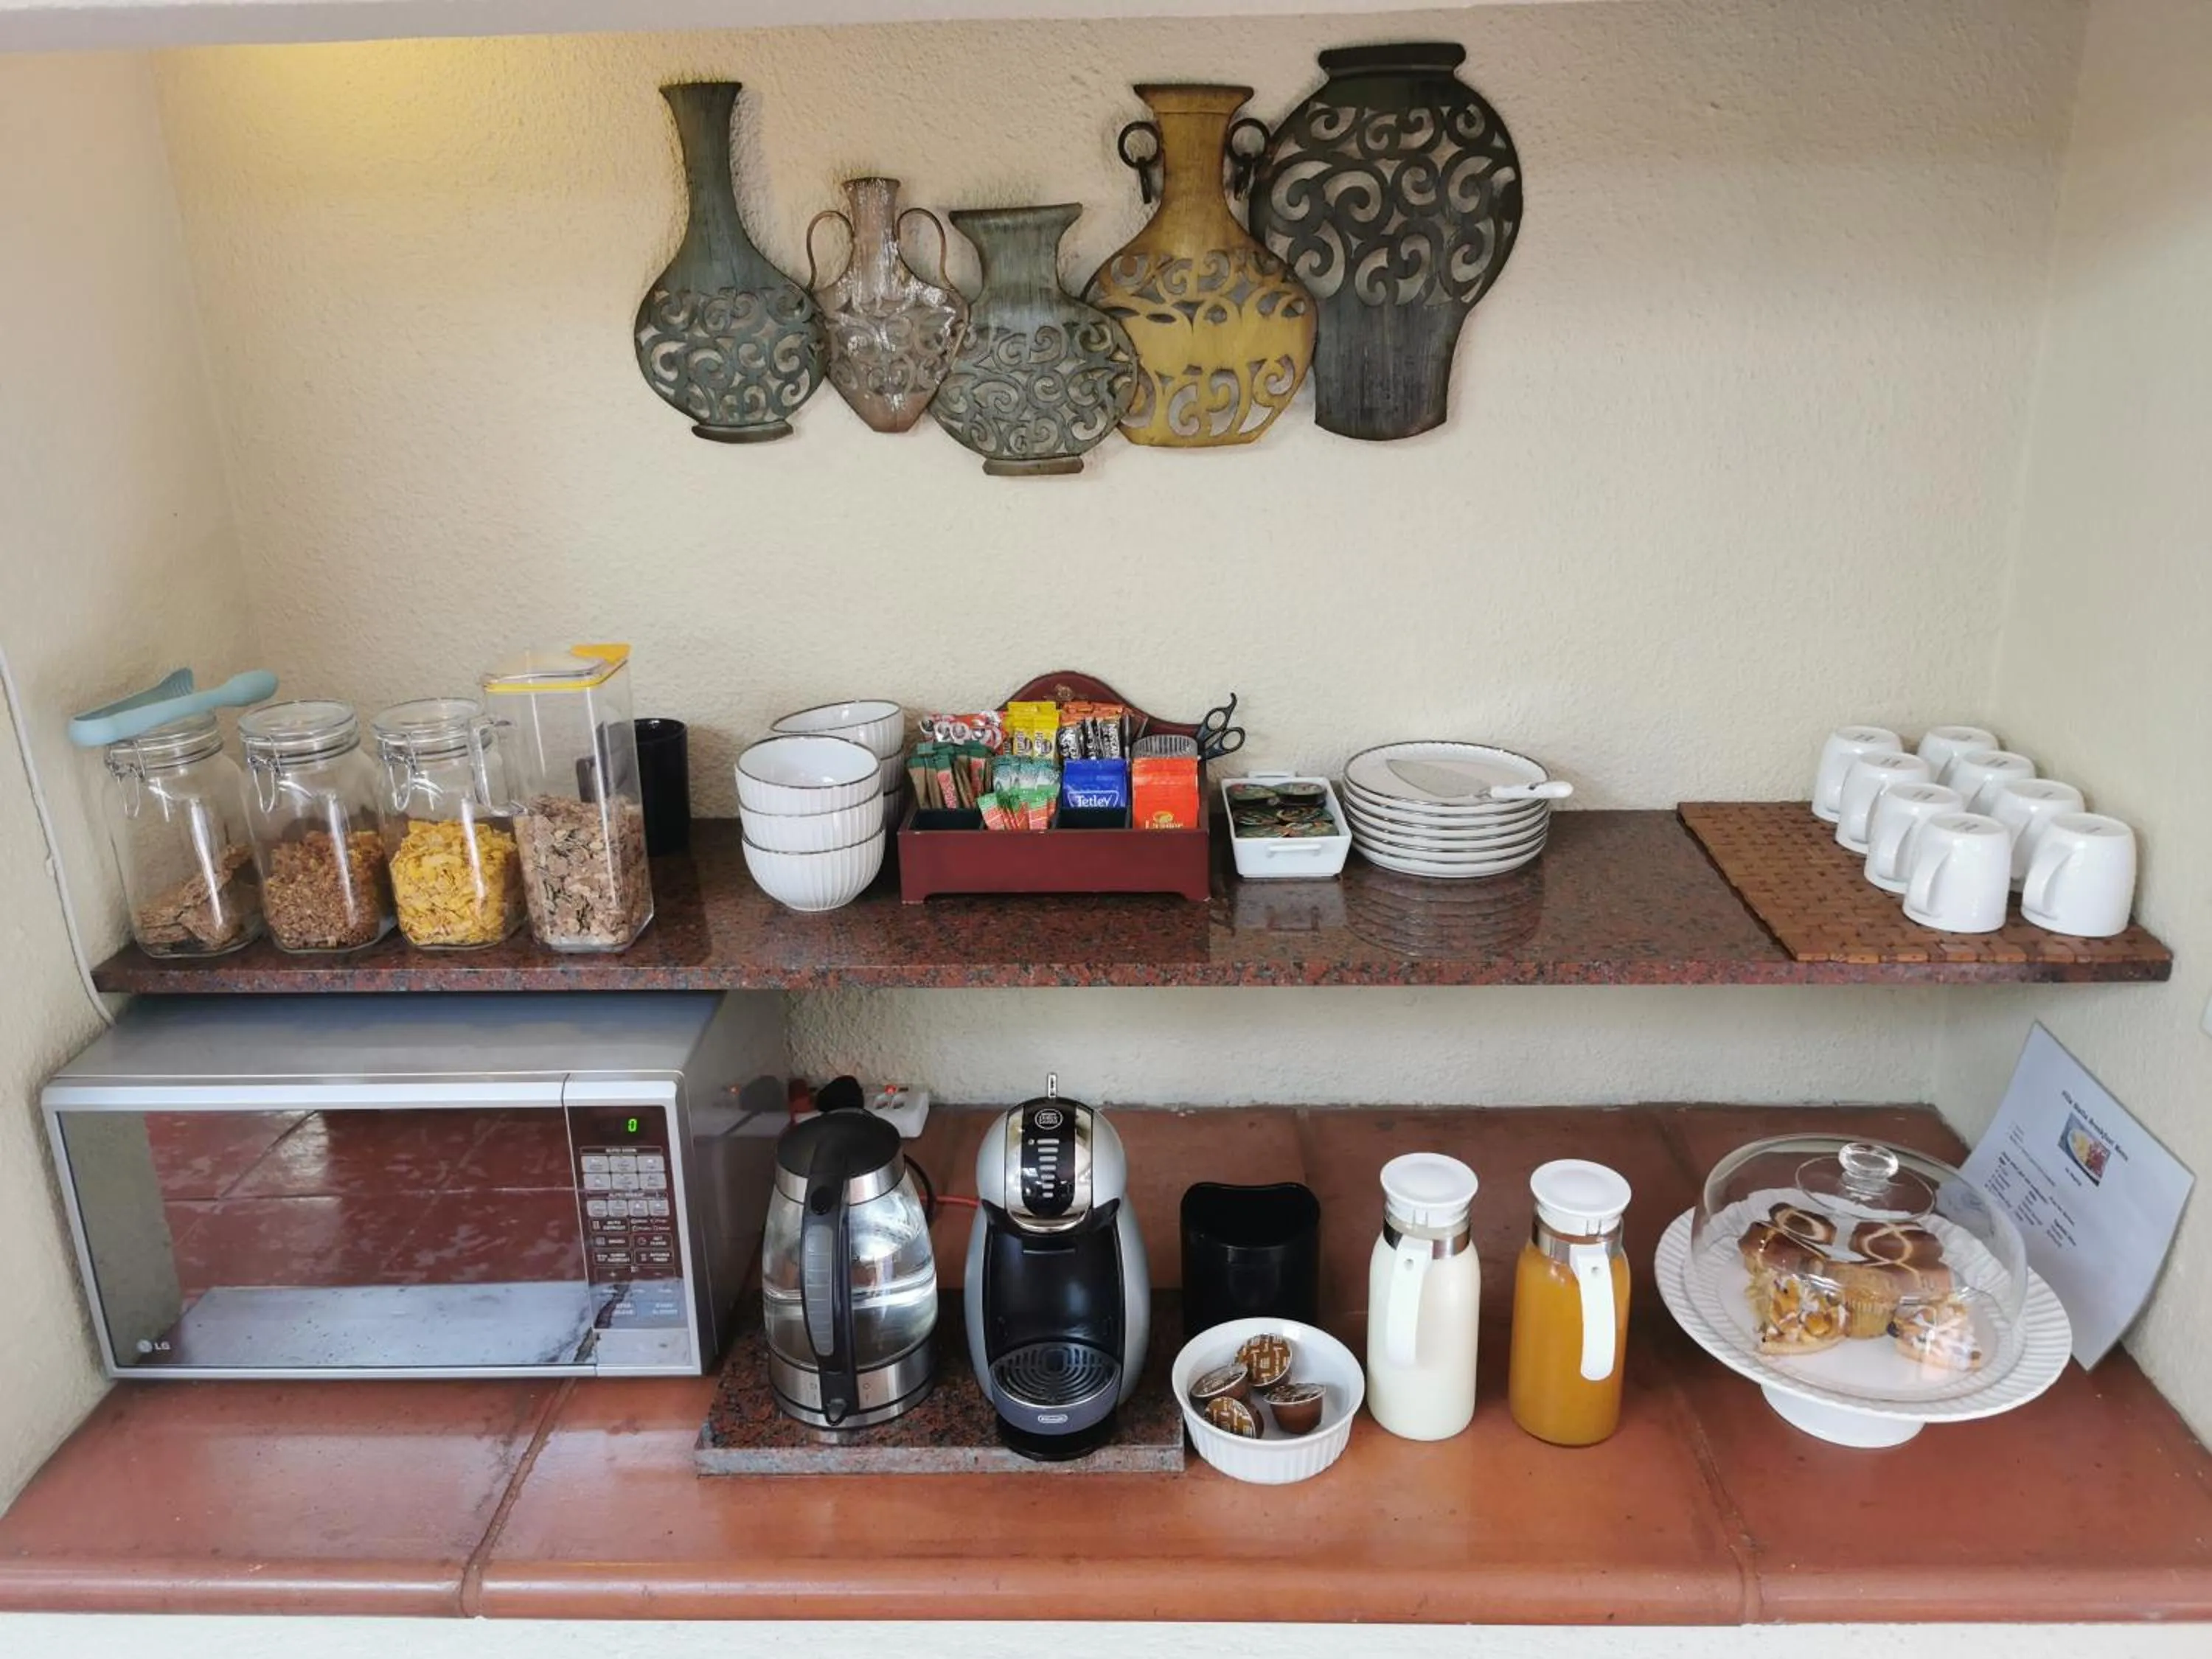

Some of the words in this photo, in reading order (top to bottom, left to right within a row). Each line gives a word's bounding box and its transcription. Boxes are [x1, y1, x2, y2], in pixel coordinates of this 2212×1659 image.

[1076, 794, 1113, 807] Tetley
[627, 1119, 638, 1133] 0
[154, 1341, 171, 1350] LG
